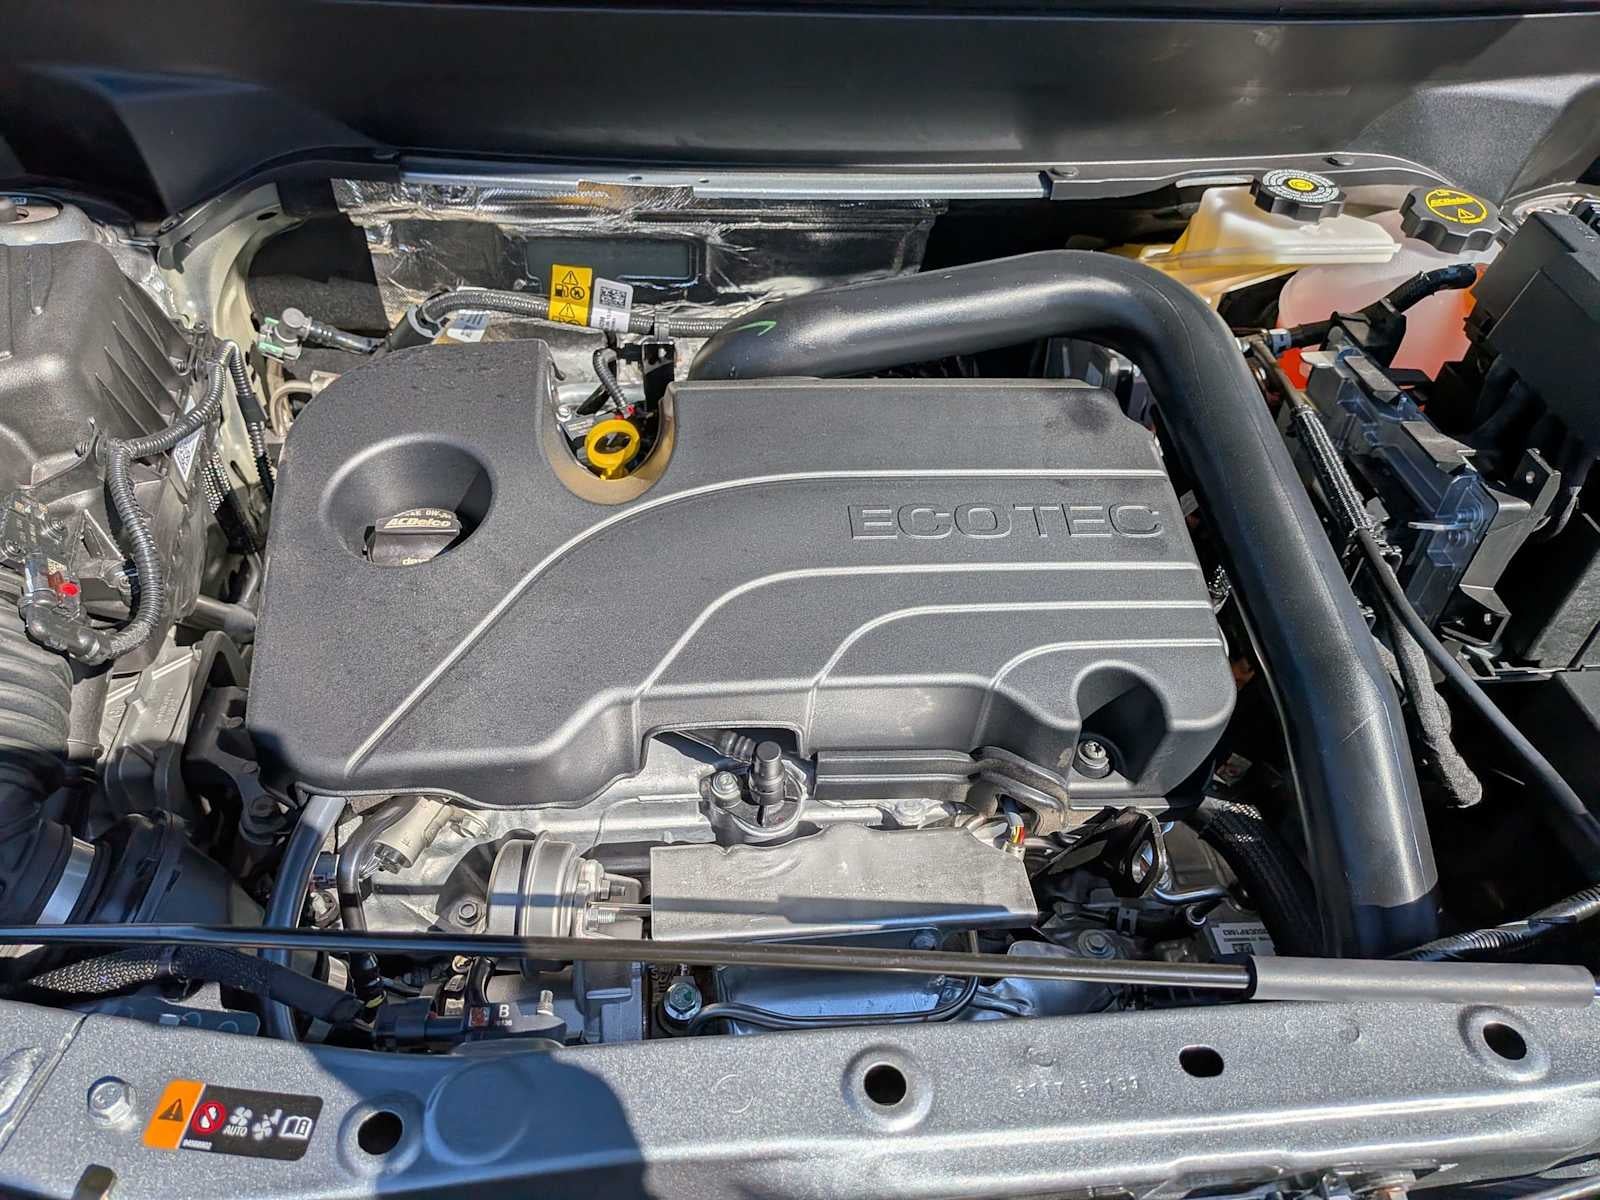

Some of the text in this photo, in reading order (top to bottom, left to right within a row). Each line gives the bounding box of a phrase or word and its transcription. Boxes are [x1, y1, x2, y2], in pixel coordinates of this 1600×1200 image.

[384, 518, 452, 529] ACDelco
[848, 502, 1165, 541] ECOTEC
[499, 1004, 510, 1018] B
[223, 1125, 247, 1136] AUTO
